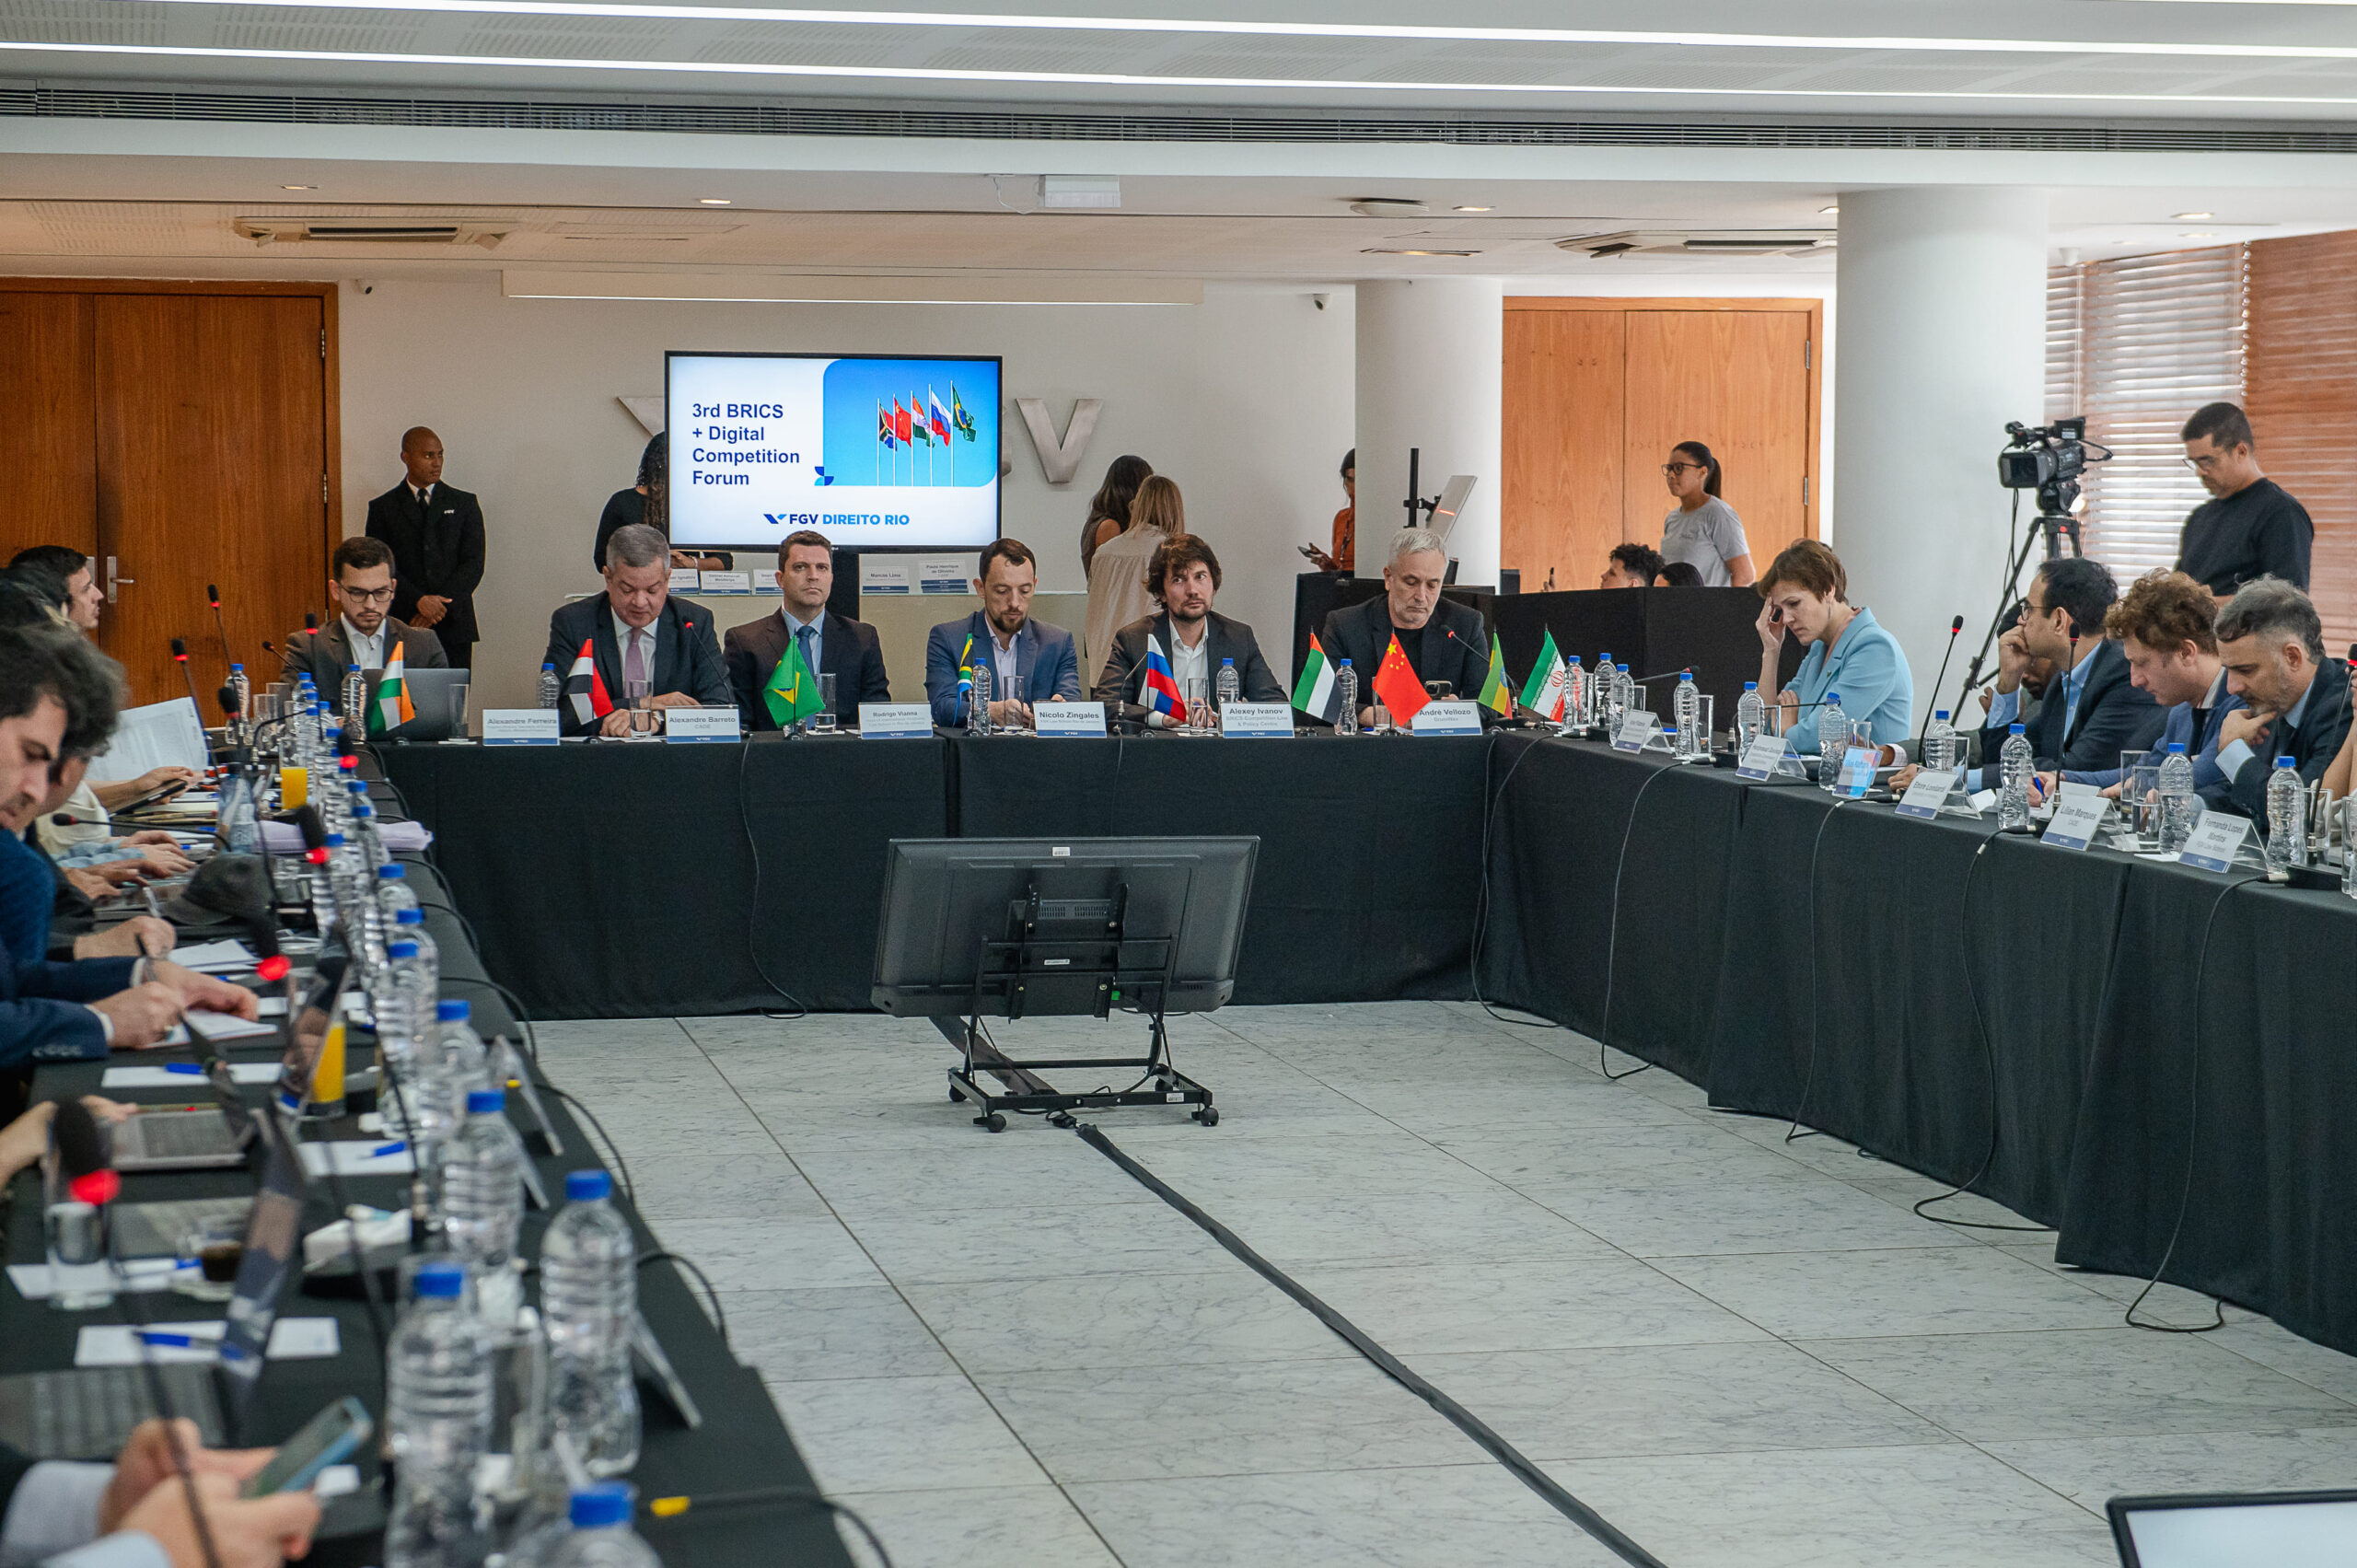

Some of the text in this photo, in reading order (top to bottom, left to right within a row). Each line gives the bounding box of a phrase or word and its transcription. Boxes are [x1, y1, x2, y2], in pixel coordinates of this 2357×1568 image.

[692, 403, 784, 418] 3rd BRICS
[692, 426, 764, 444] + Digital
[692, 447, 800, 466] Competition
[692, 470, 749, 485] Forum
[789, 514, 910, 526] FGV DIREITO RIO
